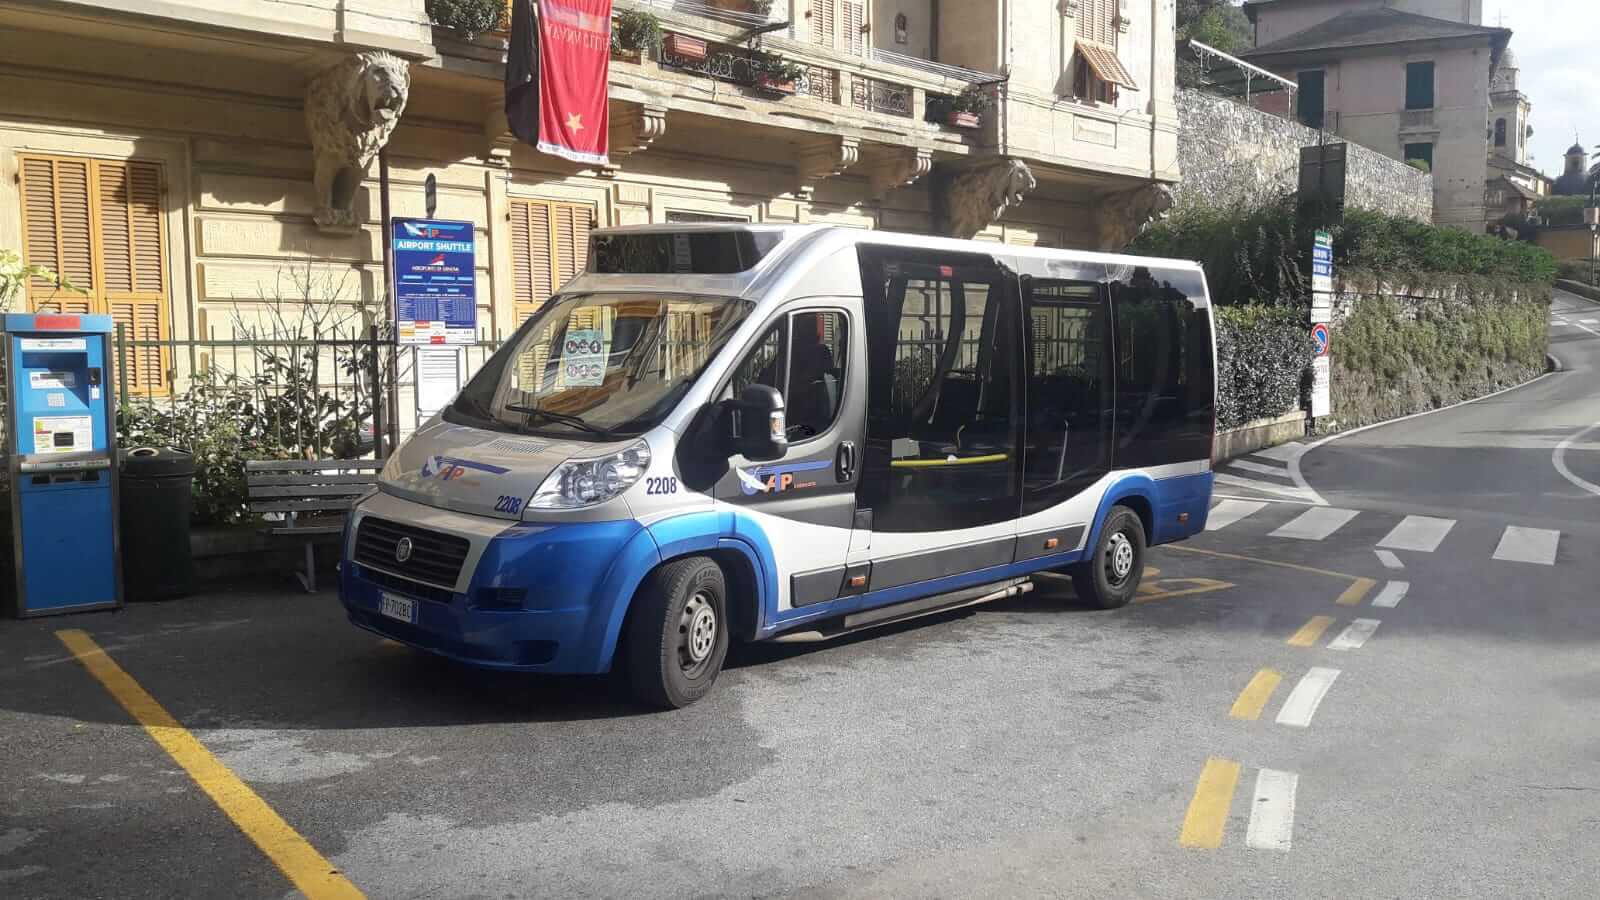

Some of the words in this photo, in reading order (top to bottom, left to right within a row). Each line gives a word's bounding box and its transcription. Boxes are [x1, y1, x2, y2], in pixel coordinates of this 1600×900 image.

[397, 241, 433, 249] AIRPORT
[436, 241, 472, 251] SHUTTLE
[646, 476, 677, 495] 2208
[766, 469, 793, 492] ATP
[495, 495, 522, 515] 2208
